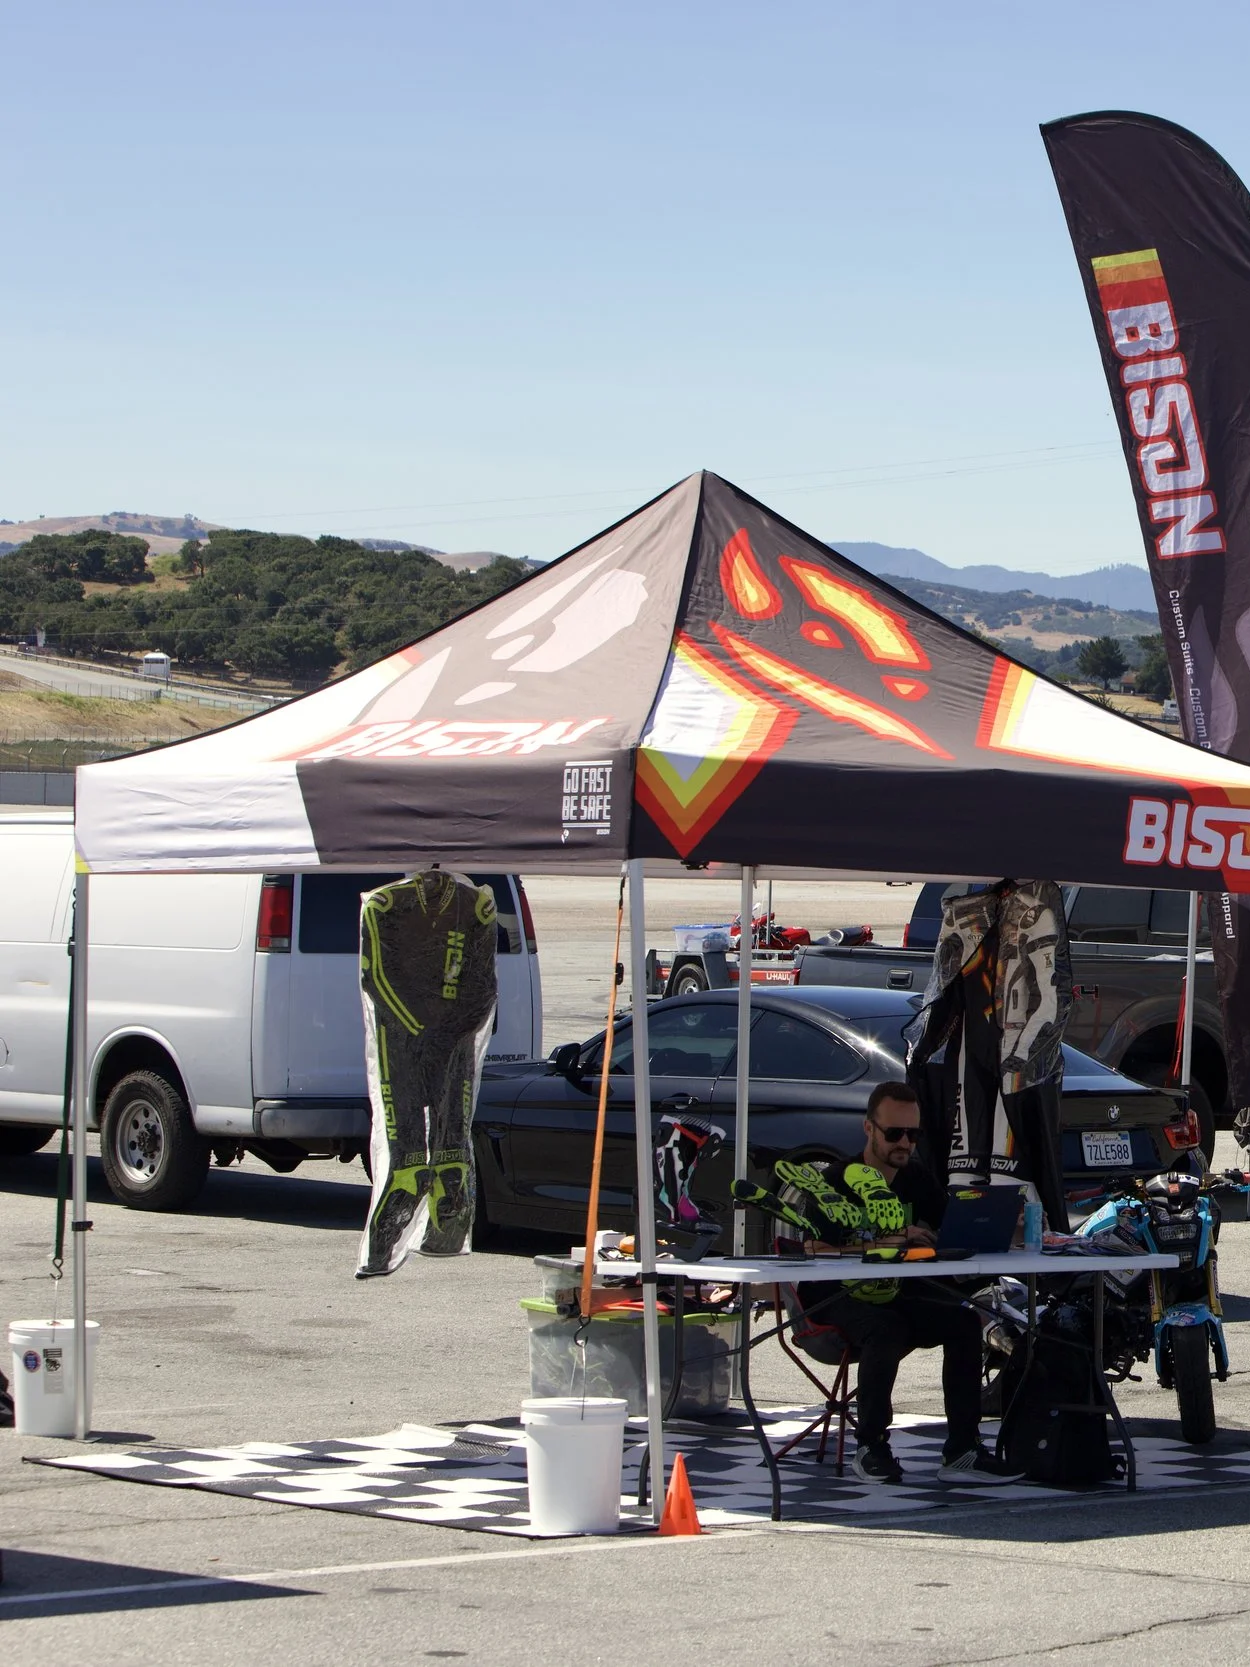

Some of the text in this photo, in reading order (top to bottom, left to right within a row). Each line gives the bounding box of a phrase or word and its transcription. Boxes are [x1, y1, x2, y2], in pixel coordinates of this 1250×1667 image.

[1105, 300, 1225, 558] BISON
[1169, 590, 1186, 639] Custom
[1181, 641, 1194, 675] Suits
[1189, 688, 1207, 738] Custom
[306, 716, 611, 762] BISON
[563, 767, 613, 793] GO FAST
[562, 795, 611, 820] BE SAFE
[443, 930, 465, 999] BISON
[766, 973, 790, 981] U-HAUL
[990, 1158, 1019, 1172] ISON
[1087, 1144, 1130, 1161] 7ZLE588
